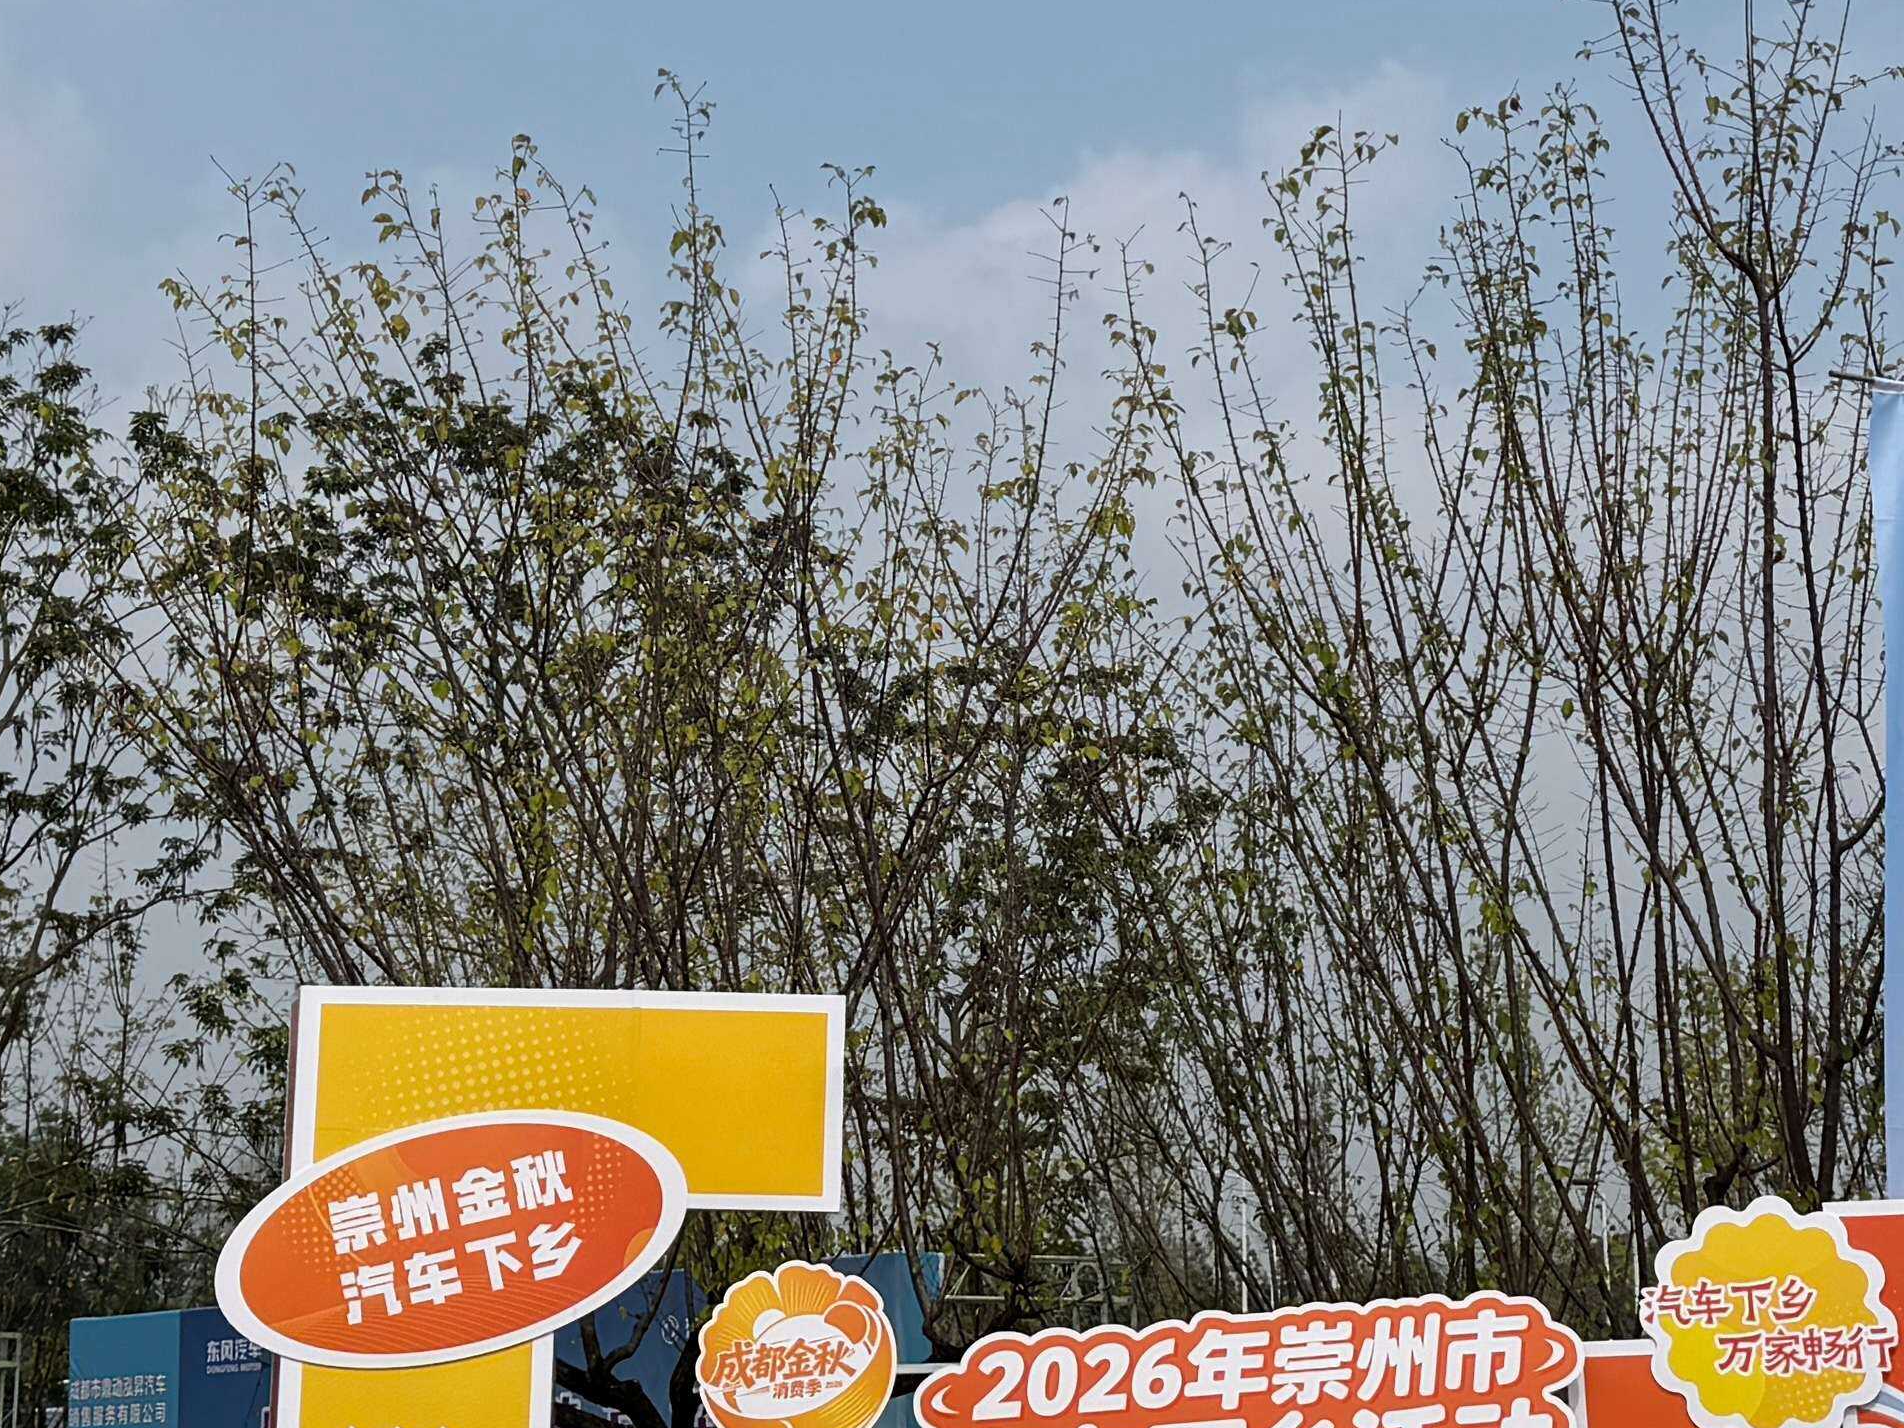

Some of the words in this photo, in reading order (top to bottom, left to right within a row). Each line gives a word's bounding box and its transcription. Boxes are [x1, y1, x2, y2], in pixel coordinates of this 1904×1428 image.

[328, 1149, 575, 1255] 崇州金秋
[341, 1224, 581, 1327] 汽车下乡
[1644, 1281, 1816, 1324] 汽车下乡
[708, 1338, 856, 1389] 成都金秋
[970, 1311, 1530, 1420] 2026年崇州市
[1716, 1325, 1894, 1376] 万家畅行
[772, 1382, 824, 1400] 消费季
